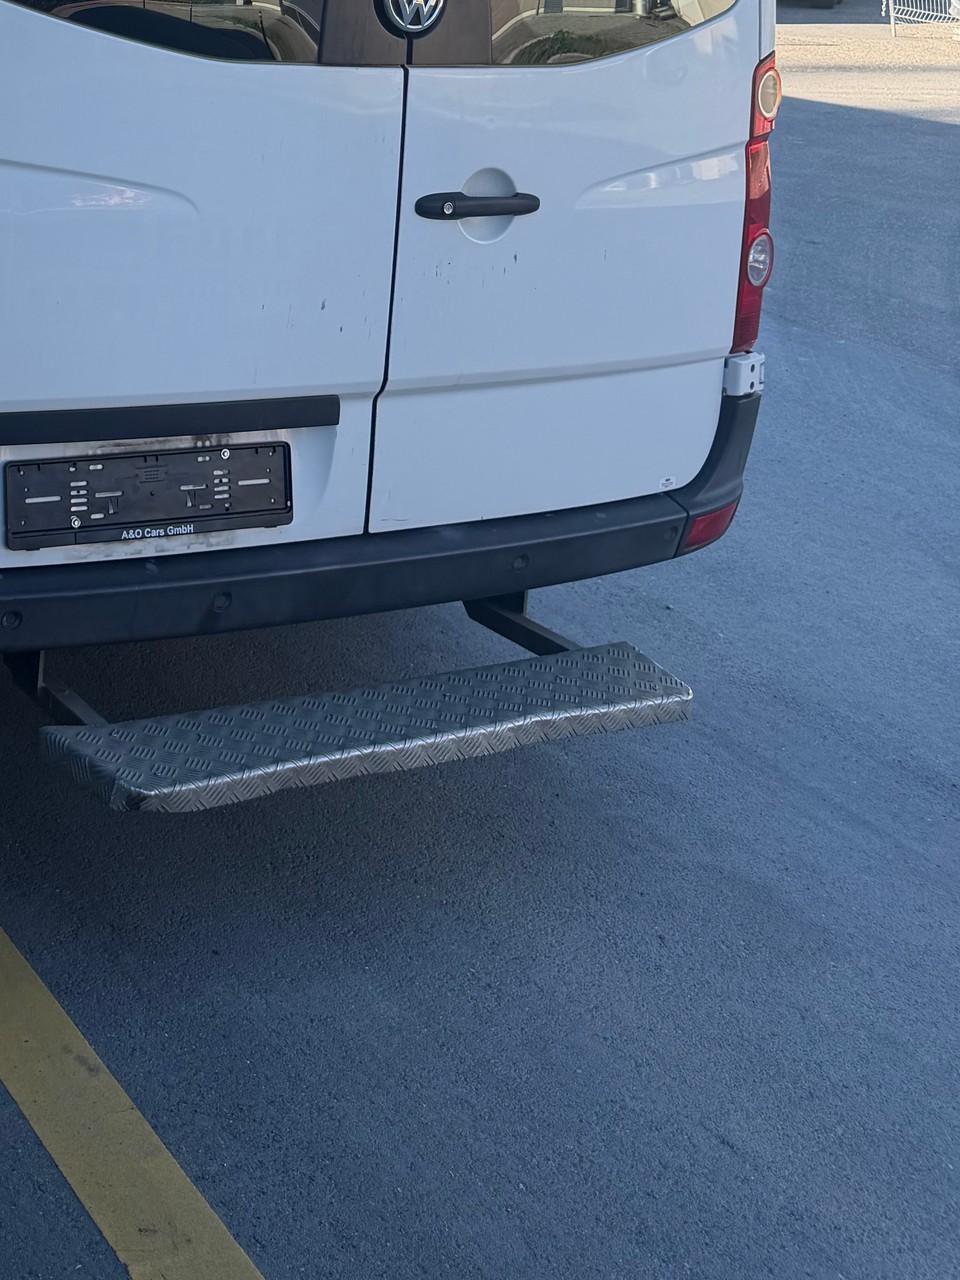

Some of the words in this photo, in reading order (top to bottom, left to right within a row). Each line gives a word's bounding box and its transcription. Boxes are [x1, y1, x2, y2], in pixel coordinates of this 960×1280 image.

[121, 529, 142, 539] A&O
[144, 528, 164, 537] Cars
[166, 524, 194, 536] GmbH
